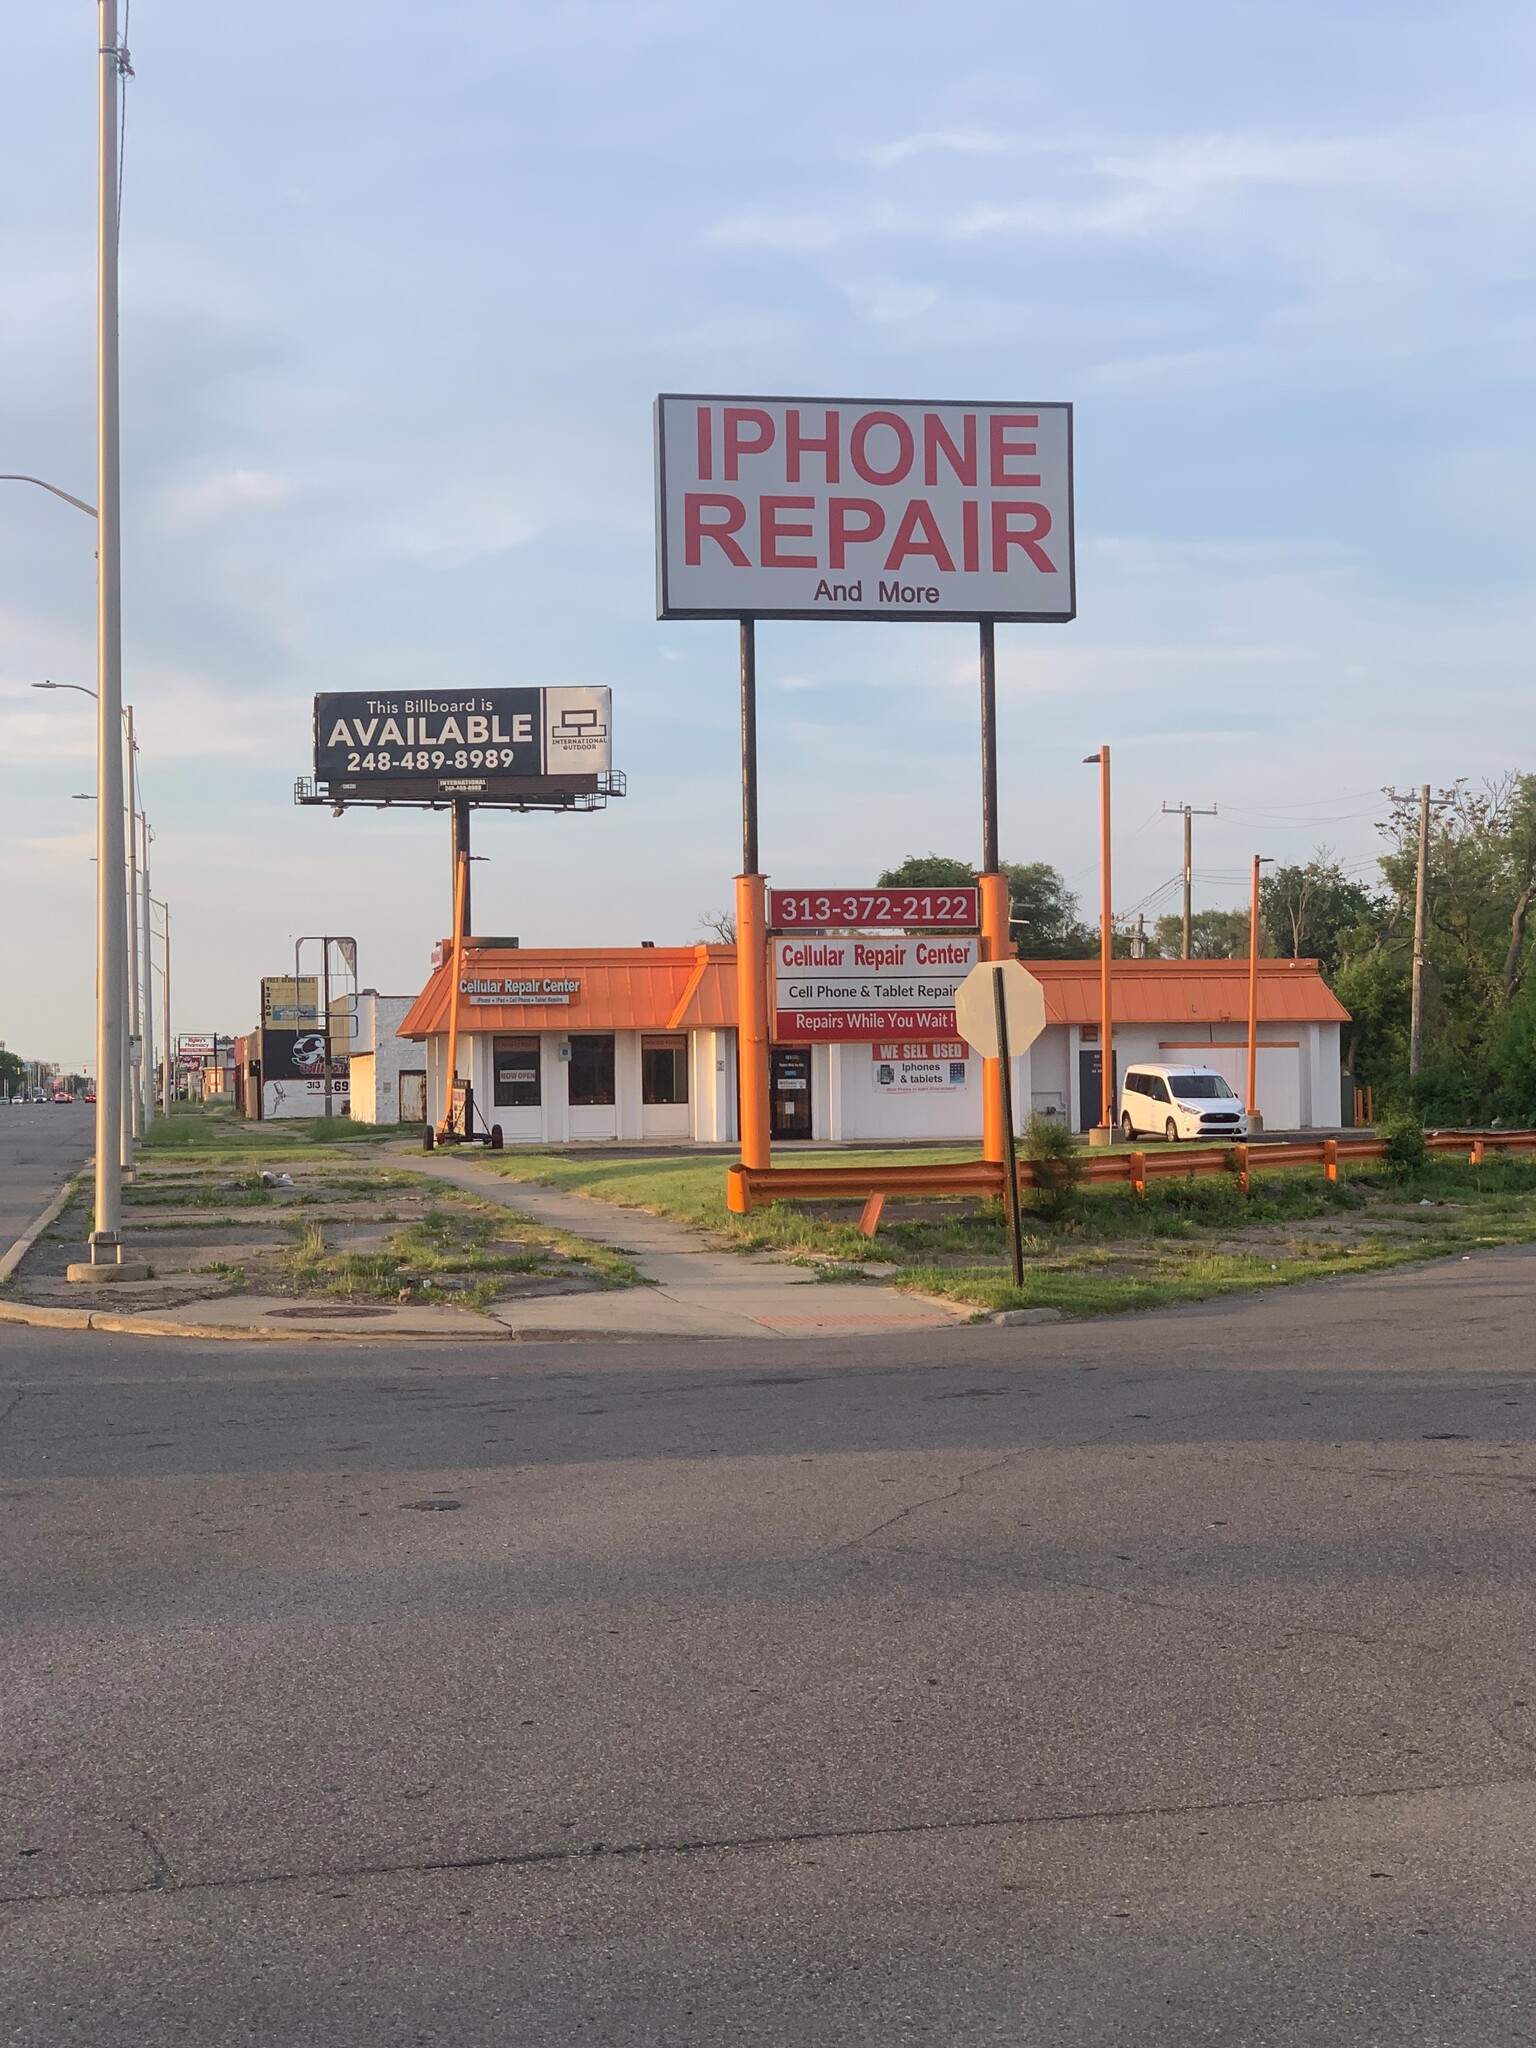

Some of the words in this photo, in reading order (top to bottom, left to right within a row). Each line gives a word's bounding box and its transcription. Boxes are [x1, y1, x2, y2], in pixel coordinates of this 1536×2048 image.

[697, 406, 1041, 487] IPHONE
[684, 492, 1058, 573] REPAIR
[814, 579, 862, 602] And
[878, 581, 940, 604] More
[367, 701, 399, 714] This
[404, 698, 475, 714] Billboard
[481, 698, 494, 711] is
[327, 714, 533, 747] AVAILABLE
[347, 748, 514, 771] 248-489-8989
[781, 896, 968, 921] 313-372-2122
[782, 944, 845, 967] Cellular
[854, 944, 906, 971] Repair
[460, 979, 502, 993] Cellular
[505, 979, 540, 995] Repair
[543, 978, 580, 992] Center
[789, 985, 813, 998] Cell
[817, 985, 857, 998] Phone
[860, 985, 870, 997] &
[874, 984, 914, 997] Tablet
[918, 984, 957, 999] Repair
[796, 1013, 844, 1031] Repairs
[847, 1013, 885, 1028] While
[888, 1013, 913, 1028] You
[880, 1044, 899, 1059] WE
[903, 1044, 928, 1059] SELL
[932, 1043, 962, 1058] USED
[501, 1072, 517, 1080] NOW
[902, 1063, 940, 1073] Iphones
[900, 1075, 907, 1083] &
[910, 1074, 943, 1083] tablets
